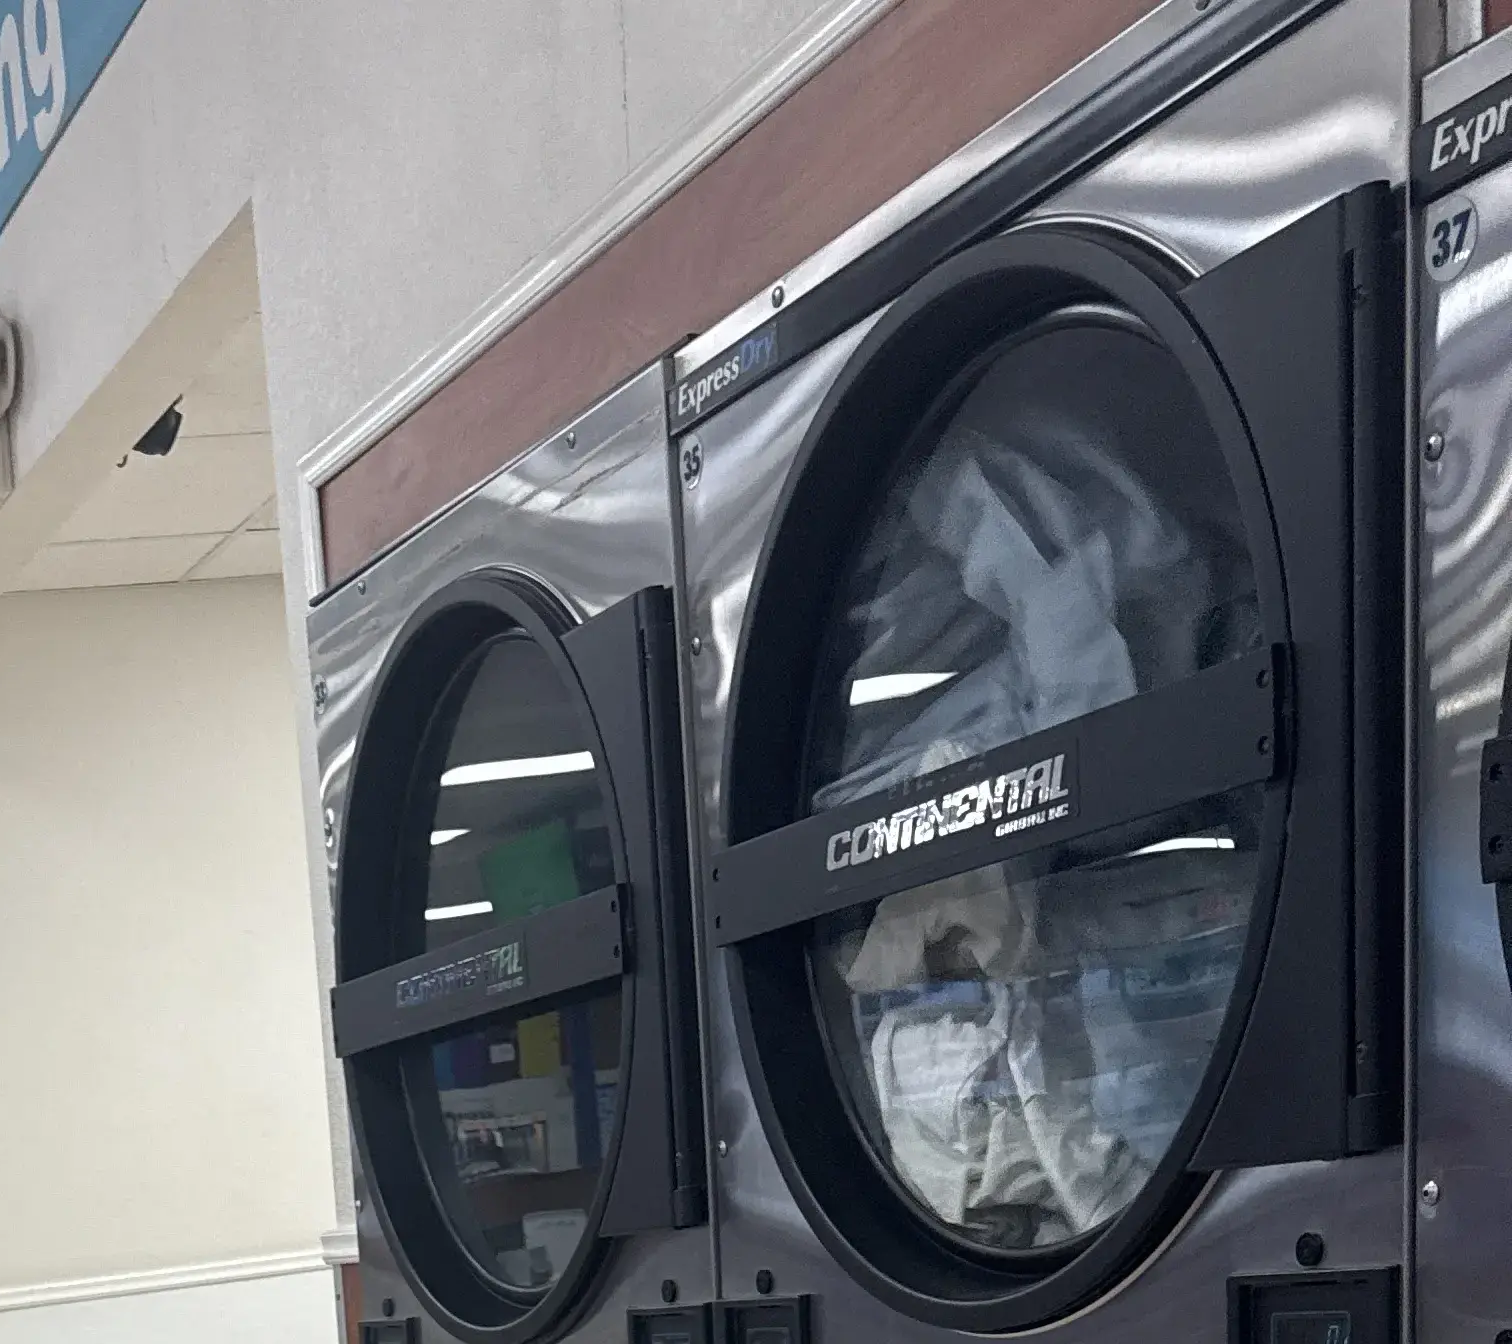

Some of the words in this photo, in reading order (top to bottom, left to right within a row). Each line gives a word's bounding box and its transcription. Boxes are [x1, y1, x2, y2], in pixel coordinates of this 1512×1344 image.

[1432, 208, 1473, 268] 37
[683, 444, 701, 481] 35
[826, 754, 1069, 871] CONTINENTAL
